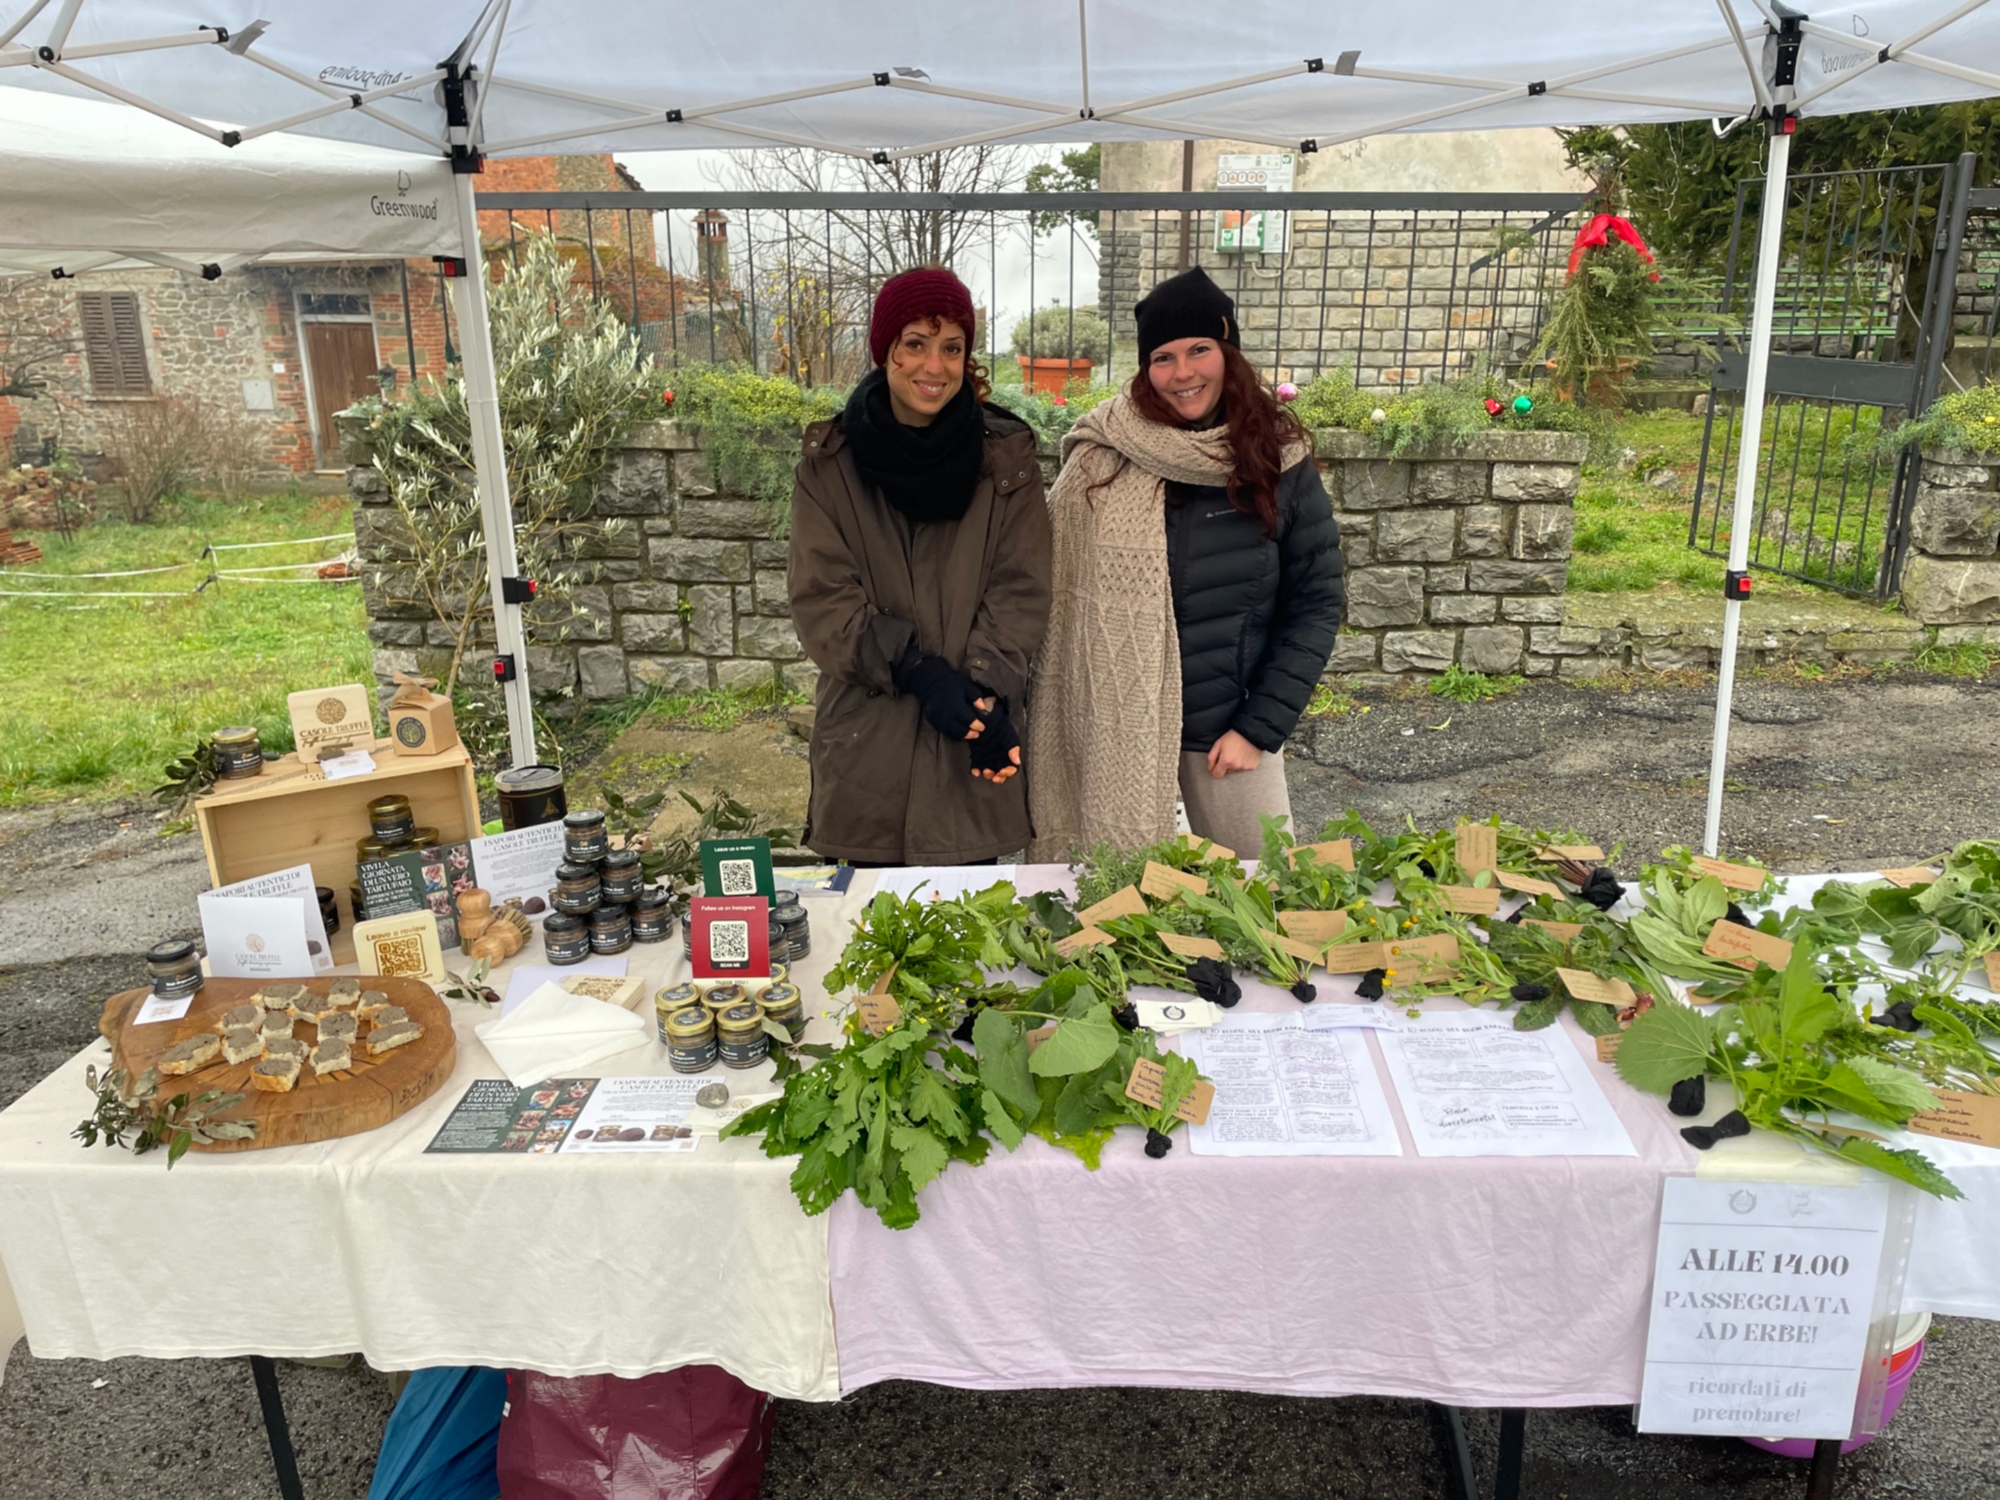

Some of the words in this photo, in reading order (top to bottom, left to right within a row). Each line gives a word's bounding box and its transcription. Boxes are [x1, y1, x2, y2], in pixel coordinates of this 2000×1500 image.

[370, 195, 438, 220] Greenwood
[300, 724, 334, 739] CASOLE
[335, 720, 370, 733] TRUFFLE
[487, 836, 515, 846] SAPORI
[517, 827, 557, 840] AUTENTICI
[493, 840, 525, 851] CASOLE
[526, 833, 560, 846] TRUFFLE
[245, 872, 291, 892] AUTENTICI
[291, 871, 301, 879] DI
[362, 865, 406, 879] GIORNATA
[386, 871, 410, 883] VERO
[258, 881, 293, 897] TRUFFLE
[365, 879, 412, 895] TARTUFAIO
[366, 932, 391, 941] Leave
[400, 925, 427, 935] review
[1679, 1248, 1766, 1273] ALLE
[1772, 1253, 1850, 1277] 14.00
[1663, 1290, 1851, 1315] PASSEGGIATA
[1695, 1321, 1738, 1341] AD
[1743, 1323, 1818, 1344] ERBE!
[1688, 1377, 1780, 1398] ricordati
[1785, 1381, 1807, 1398] di
[1692, 1405, 1801, 1424] prenotare!
